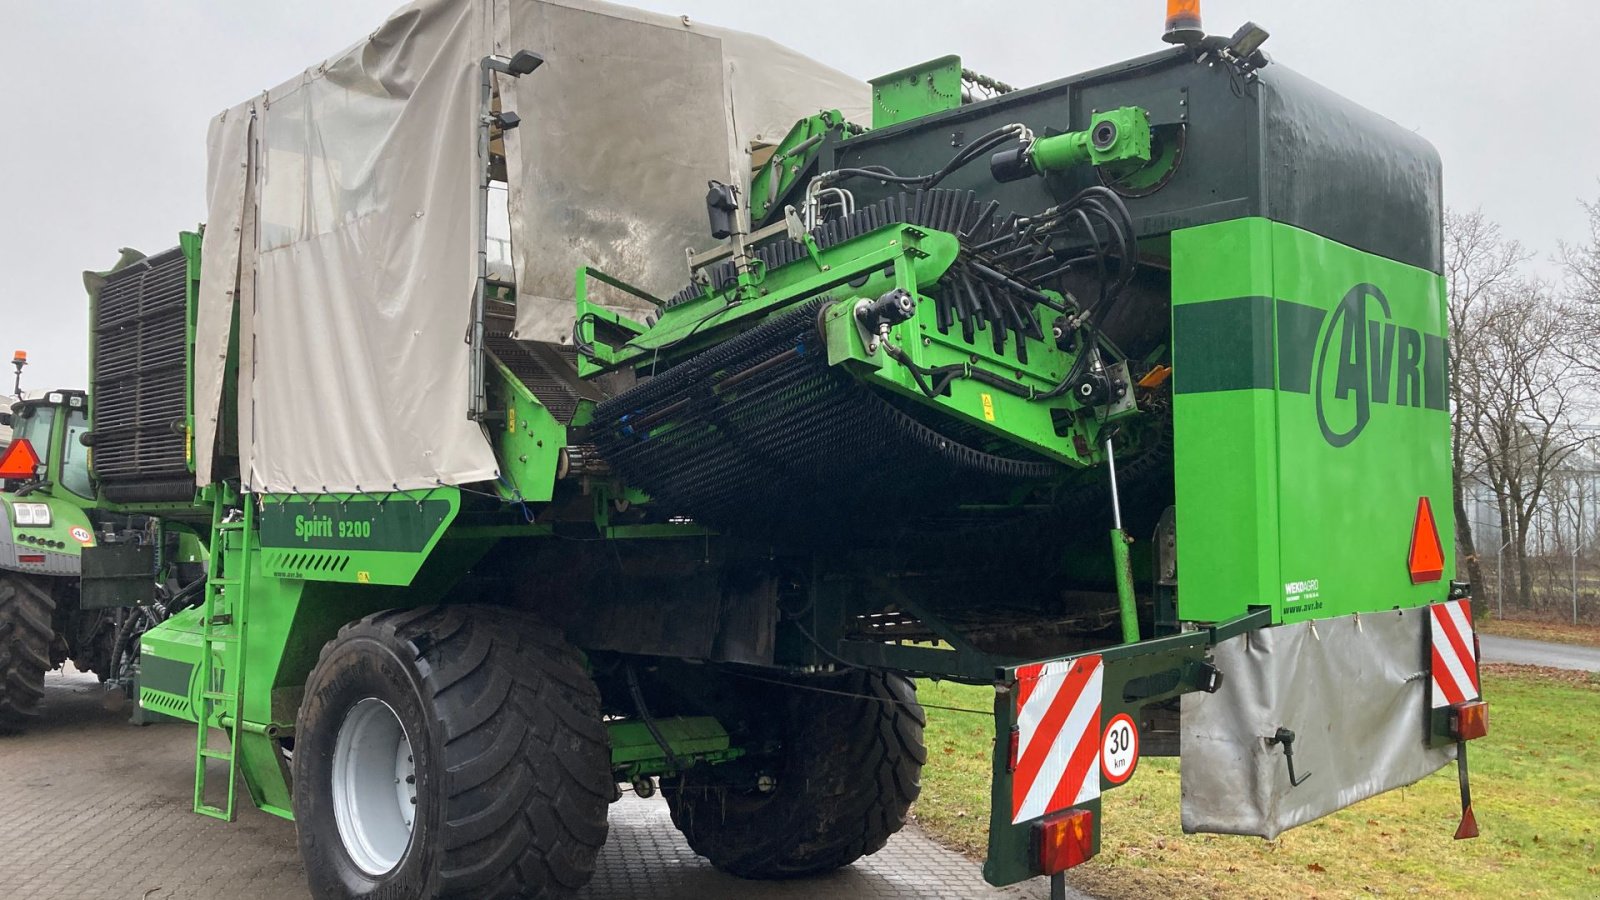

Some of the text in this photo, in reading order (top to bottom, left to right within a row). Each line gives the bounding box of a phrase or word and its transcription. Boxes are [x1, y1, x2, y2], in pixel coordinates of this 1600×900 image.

[1316, 283, 1421, 448] AVR
[74, 530, 88, 539] 40
[295, 515, 371, 542] Spirit 9200
[1283, 600, 1323, 614] www.avr.be
[1110, 726, 1129, 755] 30
[1114, 758, 1126, 769] km
